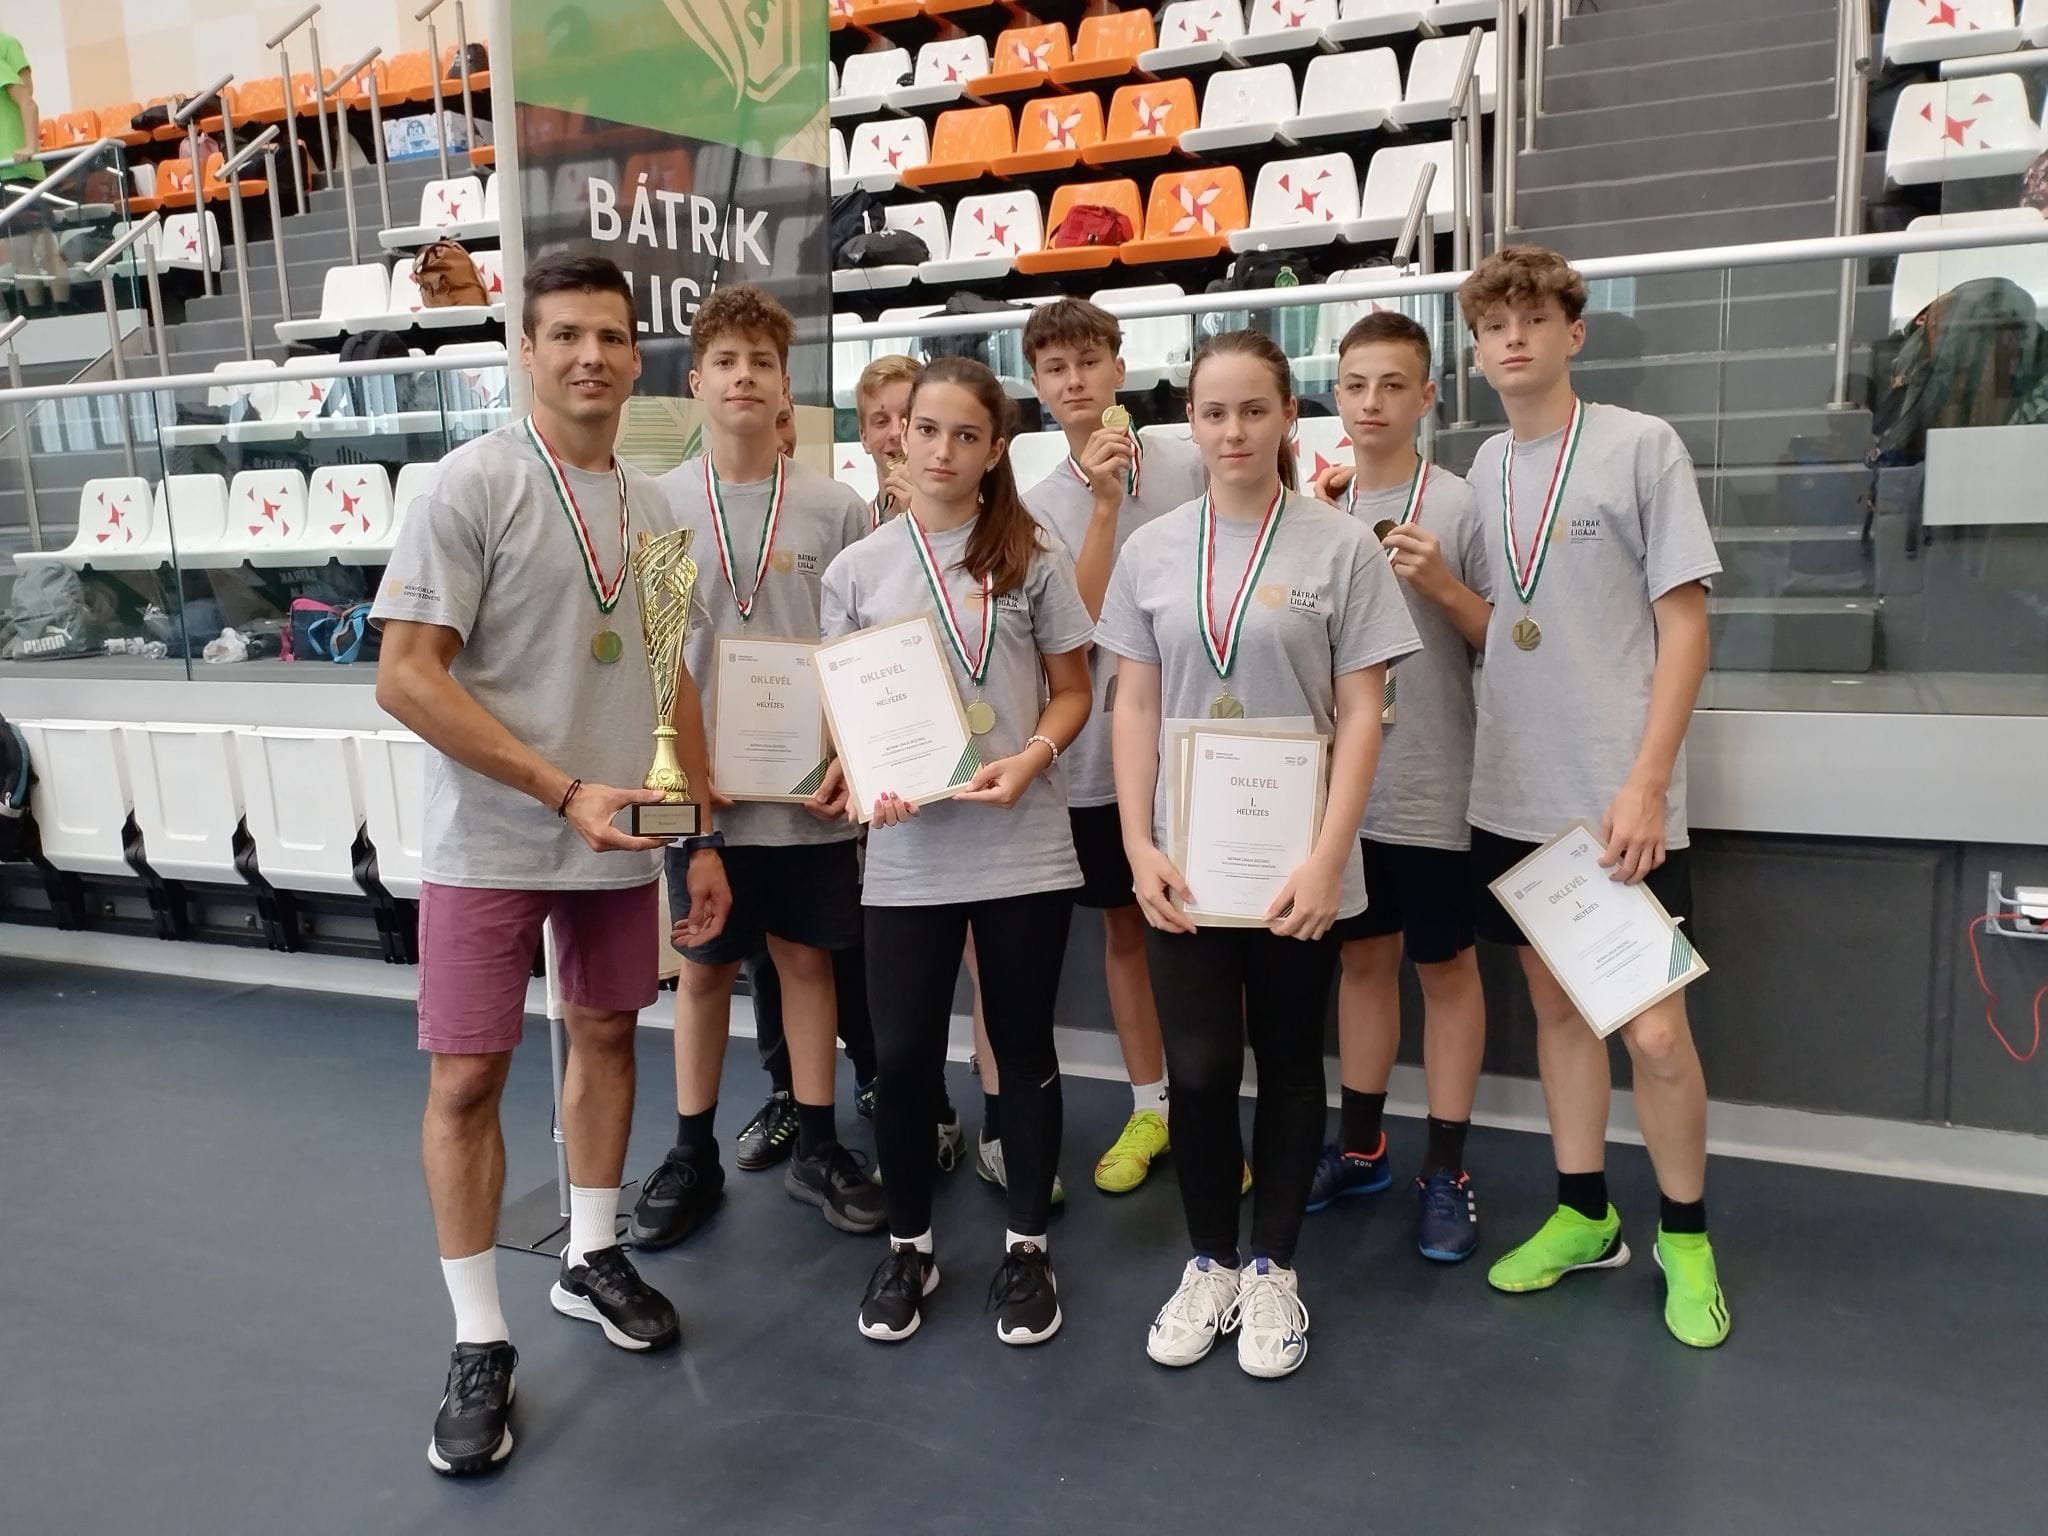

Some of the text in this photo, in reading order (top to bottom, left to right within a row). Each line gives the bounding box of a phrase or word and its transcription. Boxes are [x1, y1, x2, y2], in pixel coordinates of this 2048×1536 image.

[1571, 517, 1601, 527] BÁTRAK
[1570, 528, 1597, 536] LIGÁJA
[1291, 588, 1321, 601] BÁTRAK
[1290, 597, 1316, 609] LIGÁJA
[23, 634, 66, 654] PUMA
[860, 663, 906, 684] OKLEVÉL
[750, 674, 792, 686] OKLEVÉL
[1230, 776, 1279, 789] OKLEVÉL
[1236, 808, 1270, 817] HELYEZÉS
[1548, 875, 1589, 905] OKLEVÉL
